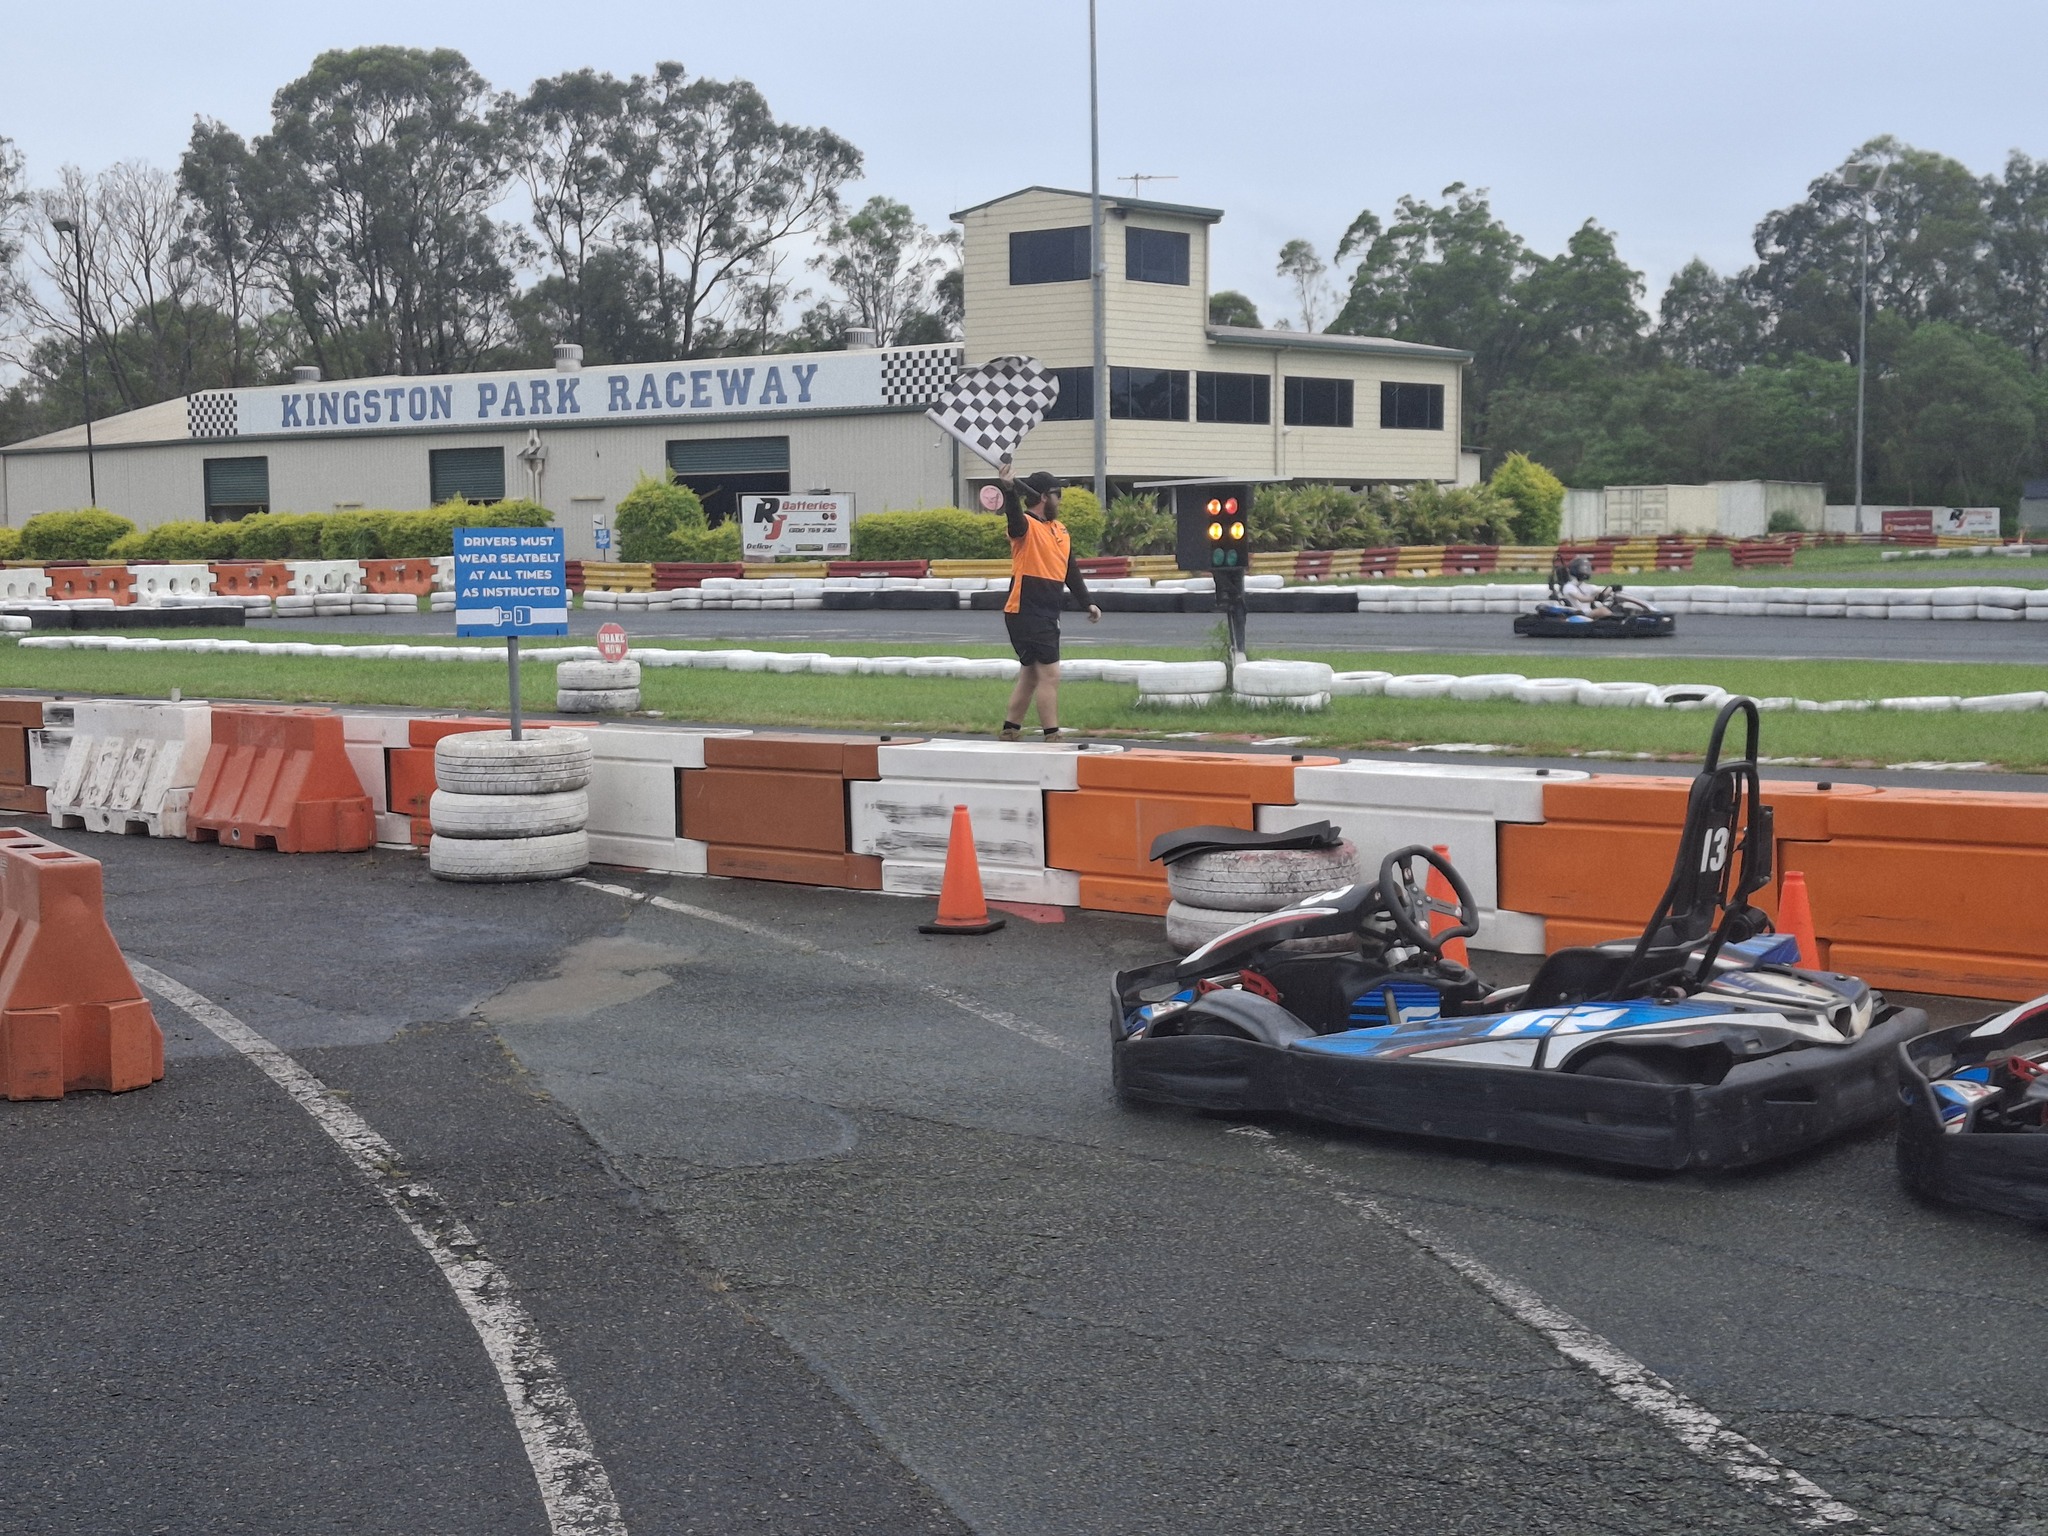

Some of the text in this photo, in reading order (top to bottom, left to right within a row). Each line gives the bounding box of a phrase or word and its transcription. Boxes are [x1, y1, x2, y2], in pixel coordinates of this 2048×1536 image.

[282, 364, 818, 427] KINGSTON PARK RACEWAY
[782, 501, 837, 511] Batteries
[463, 536, 554, 546] DRIVERS MUST
[459, 553, 560, 563] WEAR SEATBELT
[469, 570, 552, 580] AT ALL TIMES
[462, 587, 560, 597] AS INSTRUCTED
[600, 633, 625, 643] BRAKE
[1700, 827, 1729, 873] 13
